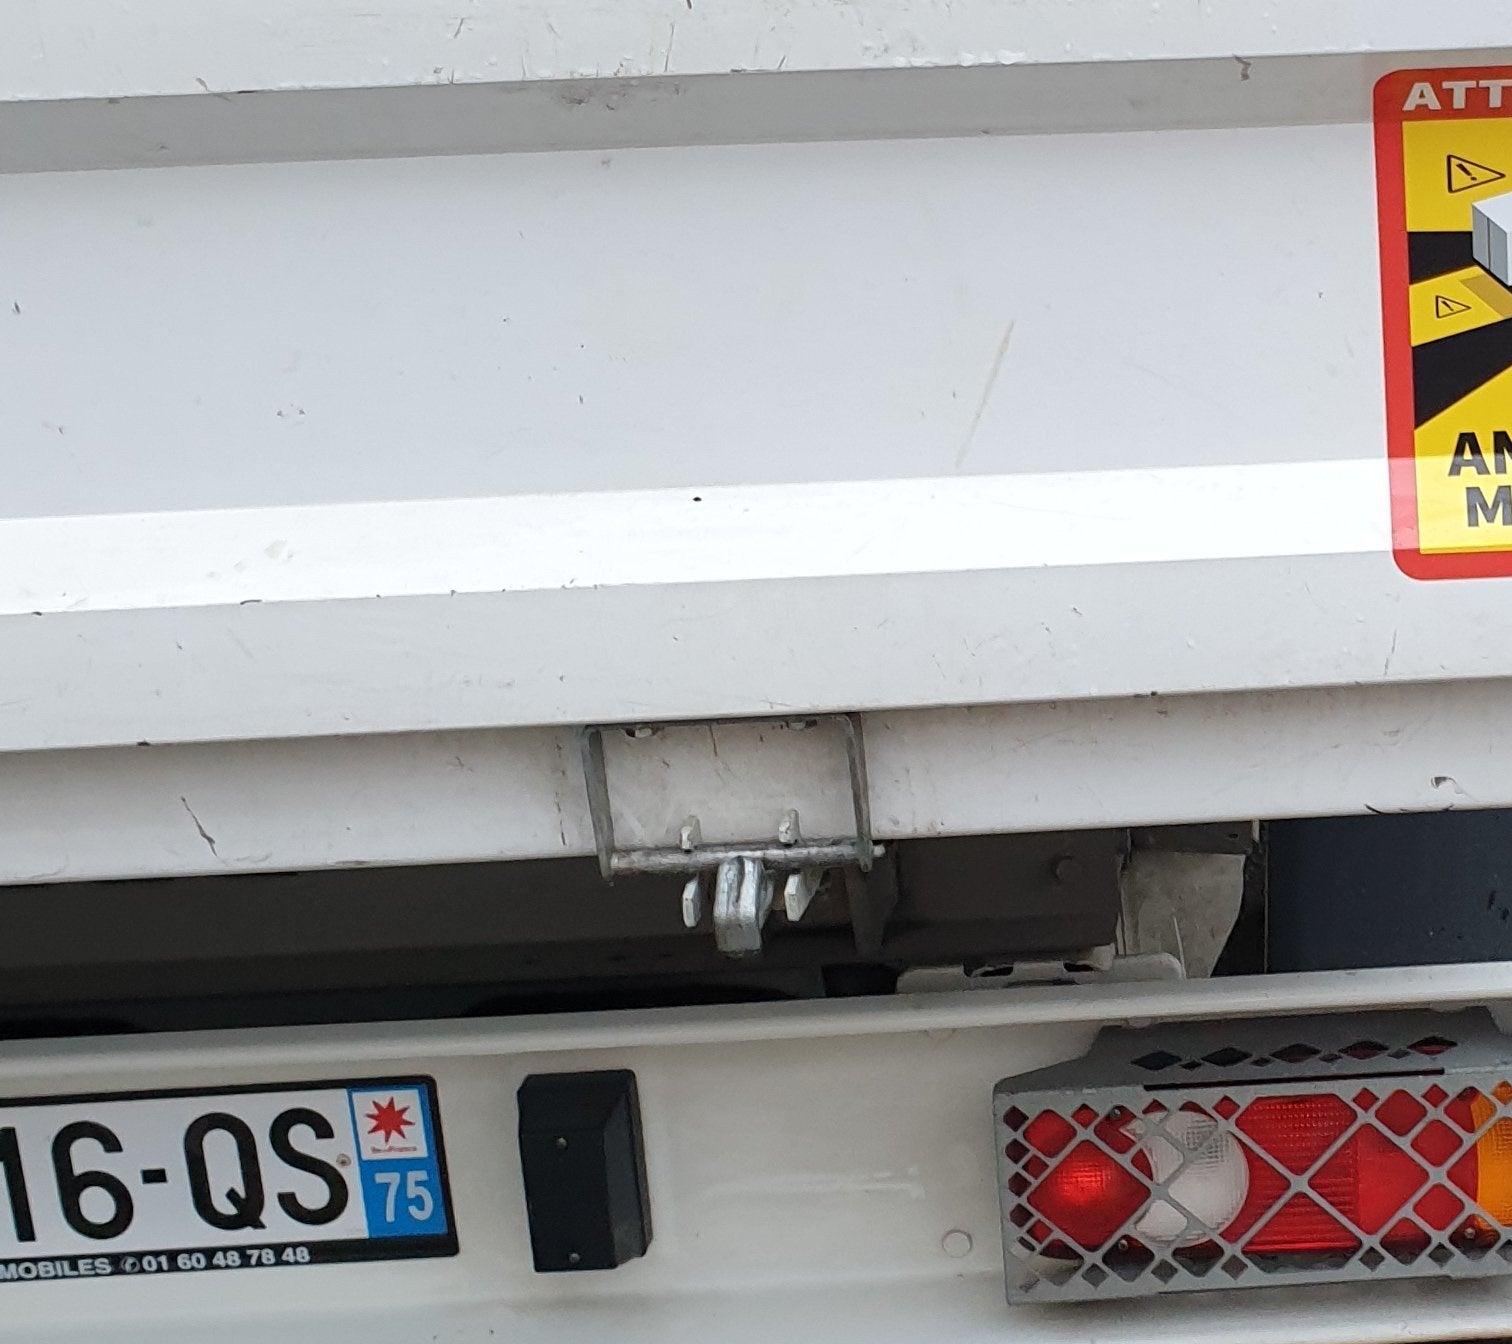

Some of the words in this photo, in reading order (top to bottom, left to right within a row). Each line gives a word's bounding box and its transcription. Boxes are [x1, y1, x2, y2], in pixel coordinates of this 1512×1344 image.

[375, 1170, 433, 1223] 75
[0, 1257, 112, 1279] MOBILES
[141, 1254, 169, 1272] 01
[177, 1253, 206, 1270] 60
[212, 1250, 242, 1268] 48
[246, 1248, 275, 1266] 78
[282, 1246, 311, 1263] 48
